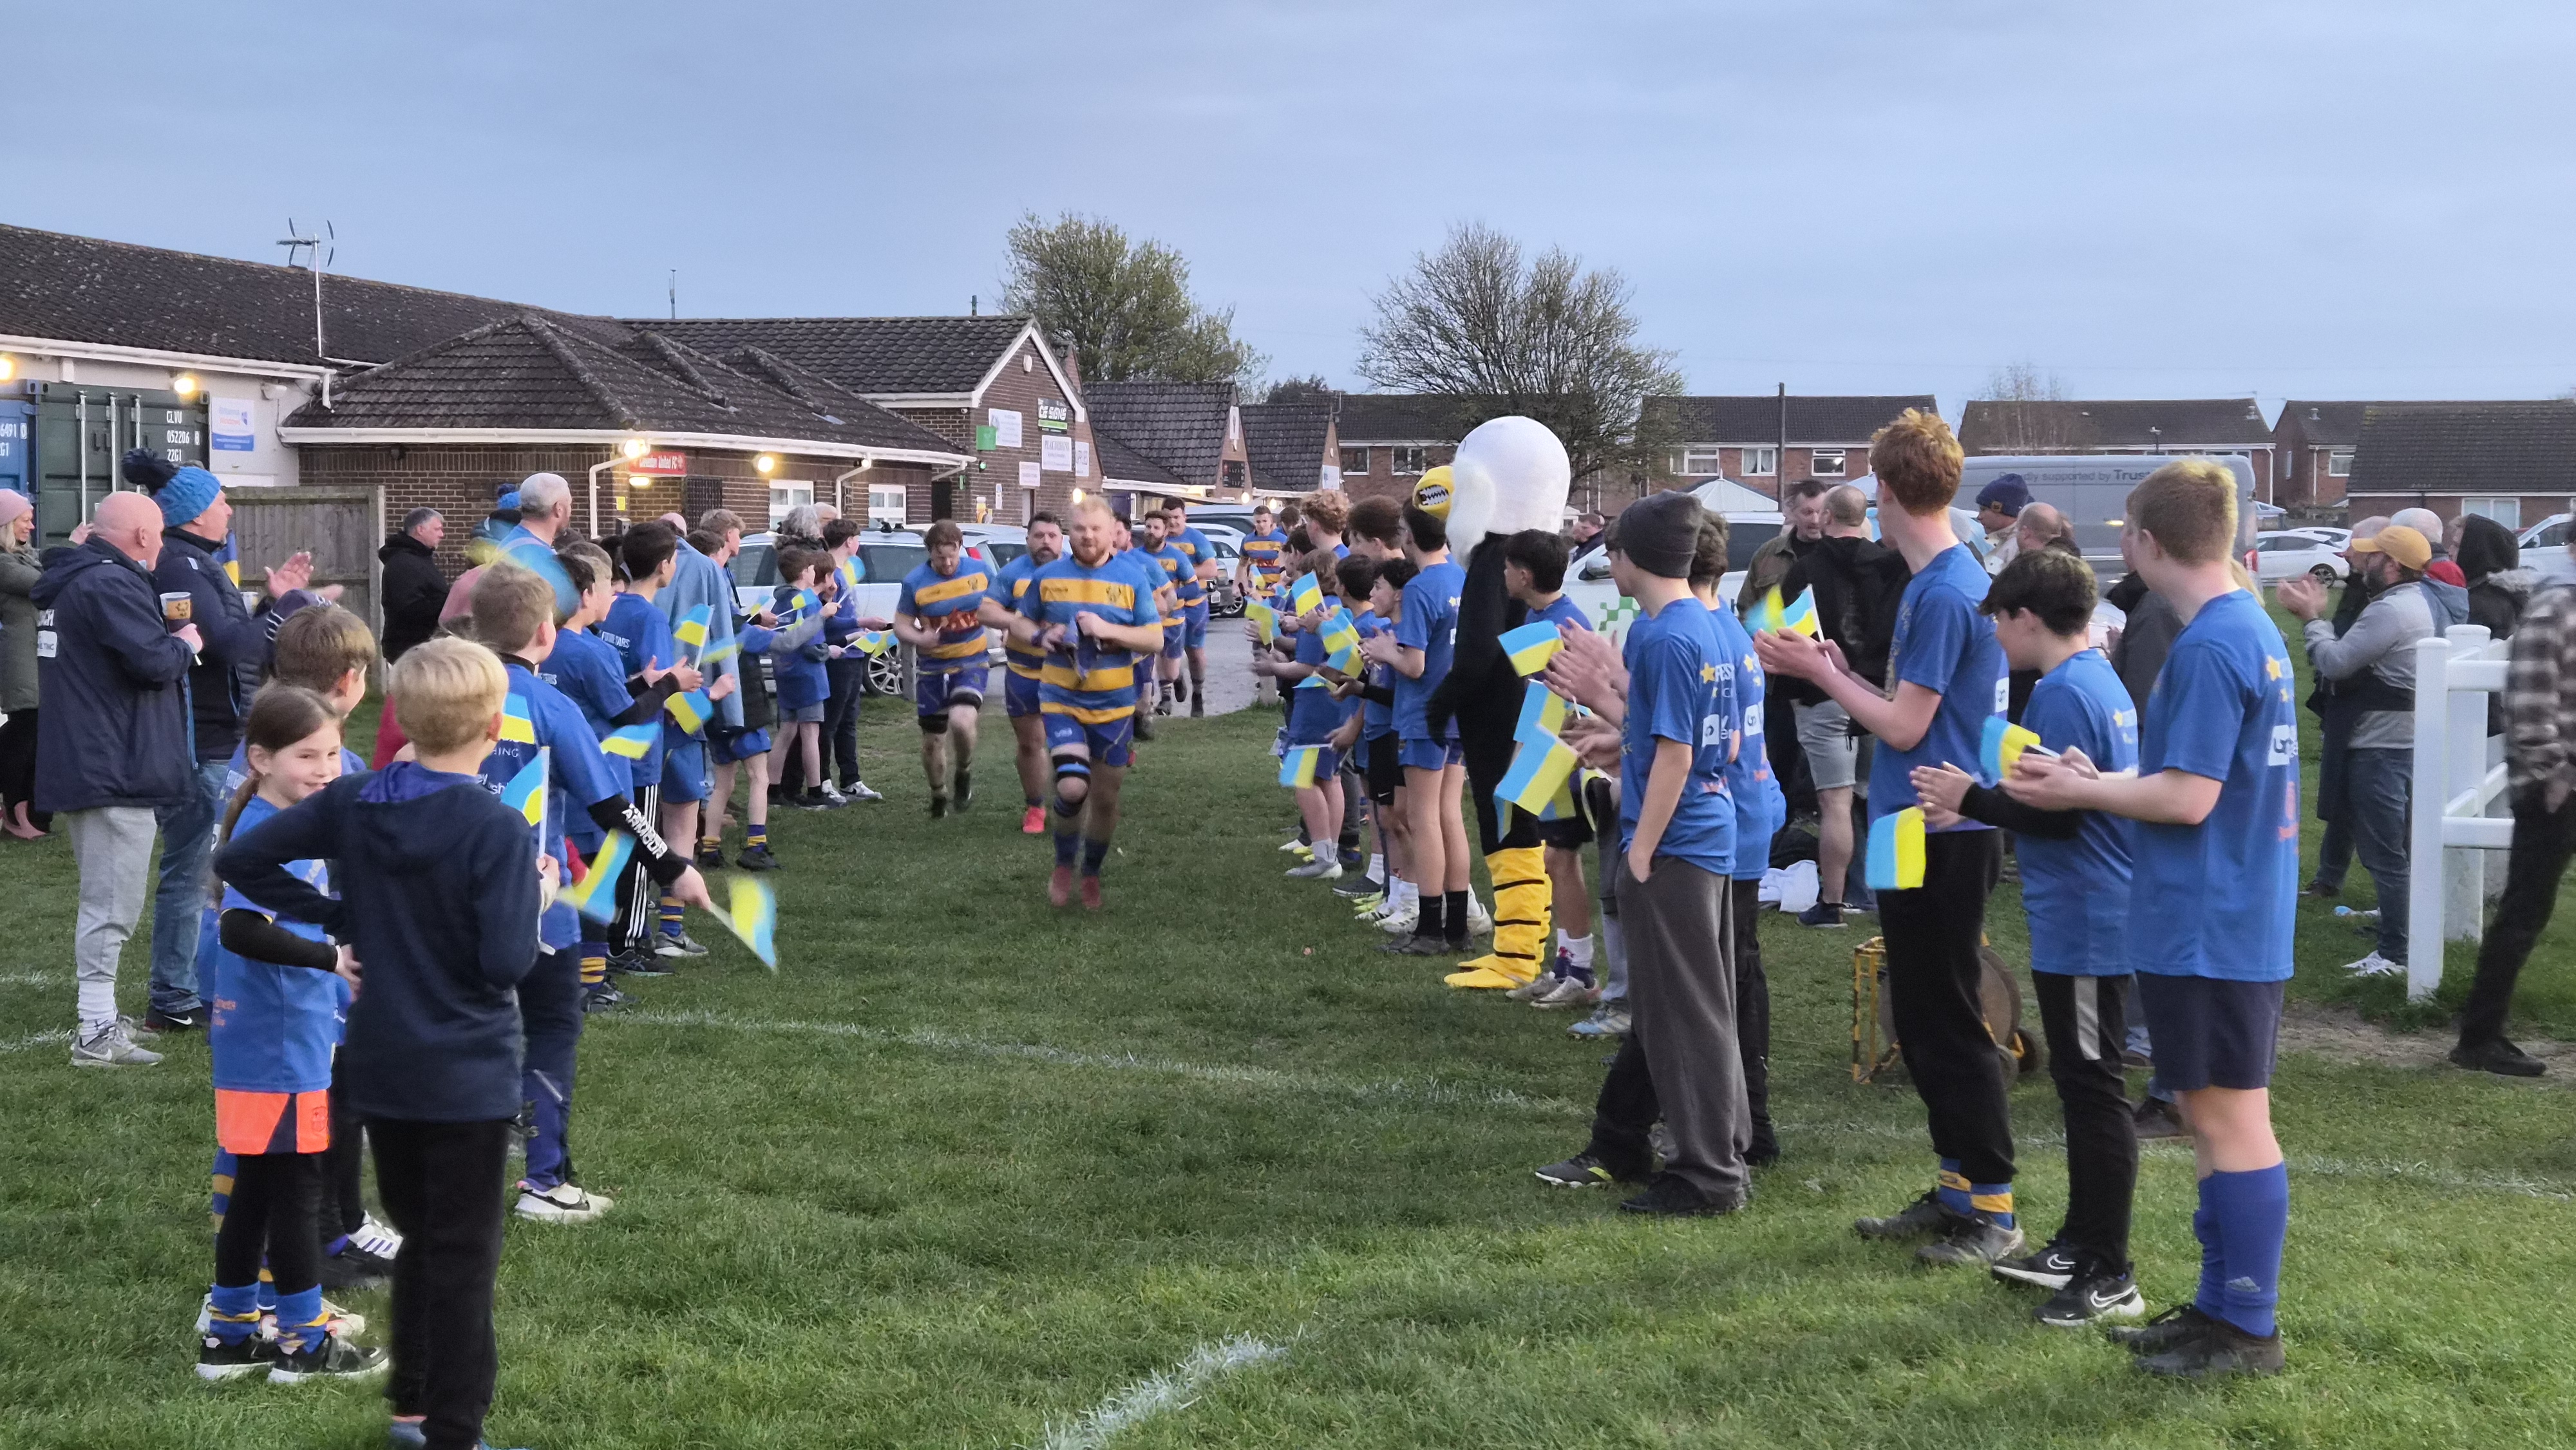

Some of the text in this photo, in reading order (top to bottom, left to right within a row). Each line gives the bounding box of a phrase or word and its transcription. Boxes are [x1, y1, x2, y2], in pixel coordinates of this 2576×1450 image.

[167, 430, 190, 444] 052206
[167, 449, 182, 462] 22G1
[2042, 471, 2096, 483] supported
[2098, 471, 2111, 484] by
